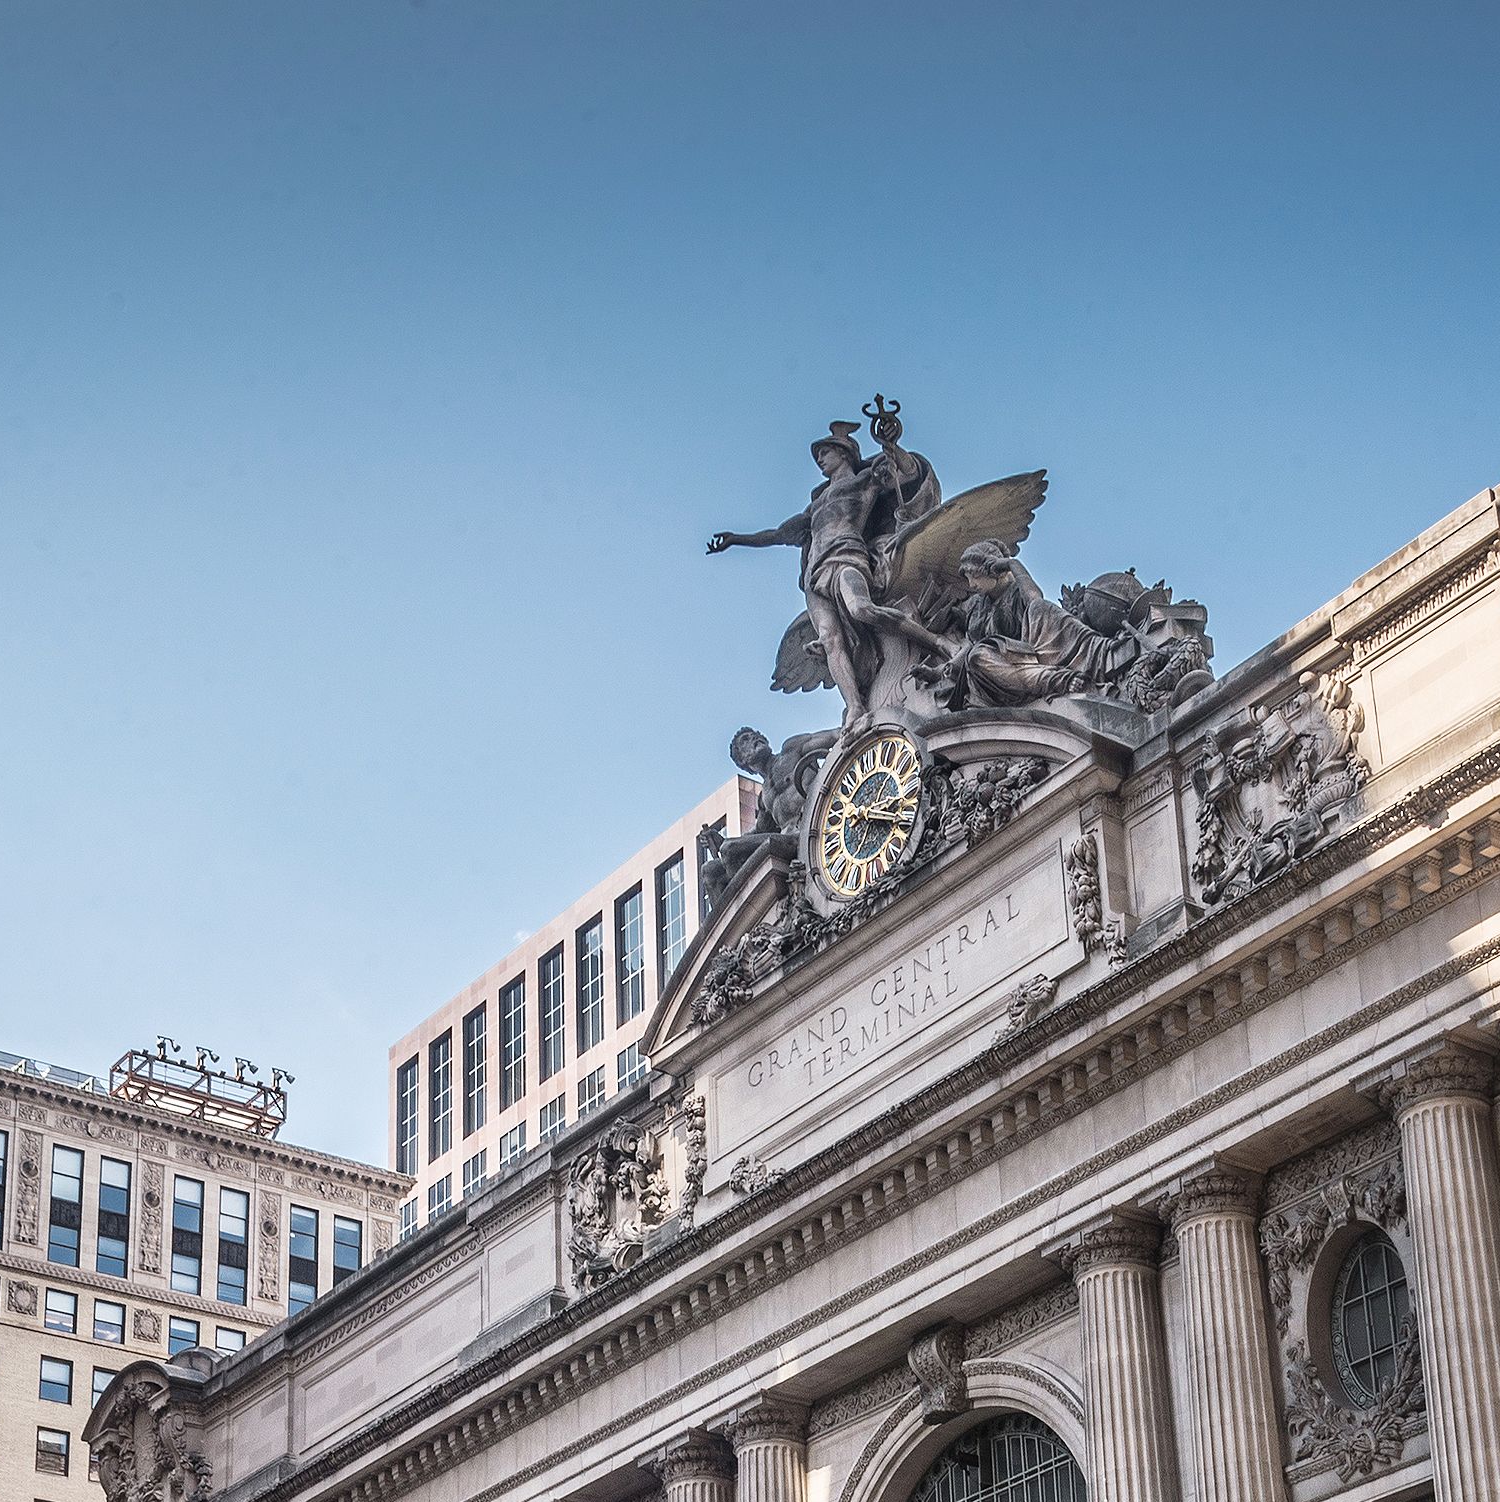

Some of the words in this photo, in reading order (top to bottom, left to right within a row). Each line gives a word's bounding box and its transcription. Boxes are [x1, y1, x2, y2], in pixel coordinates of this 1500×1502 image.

[748, 1007, 848, 1087] GRAND
[870, 894, 1021, 1006] CENTRAL
[803, 970, 958, 1086] TERMINAL
